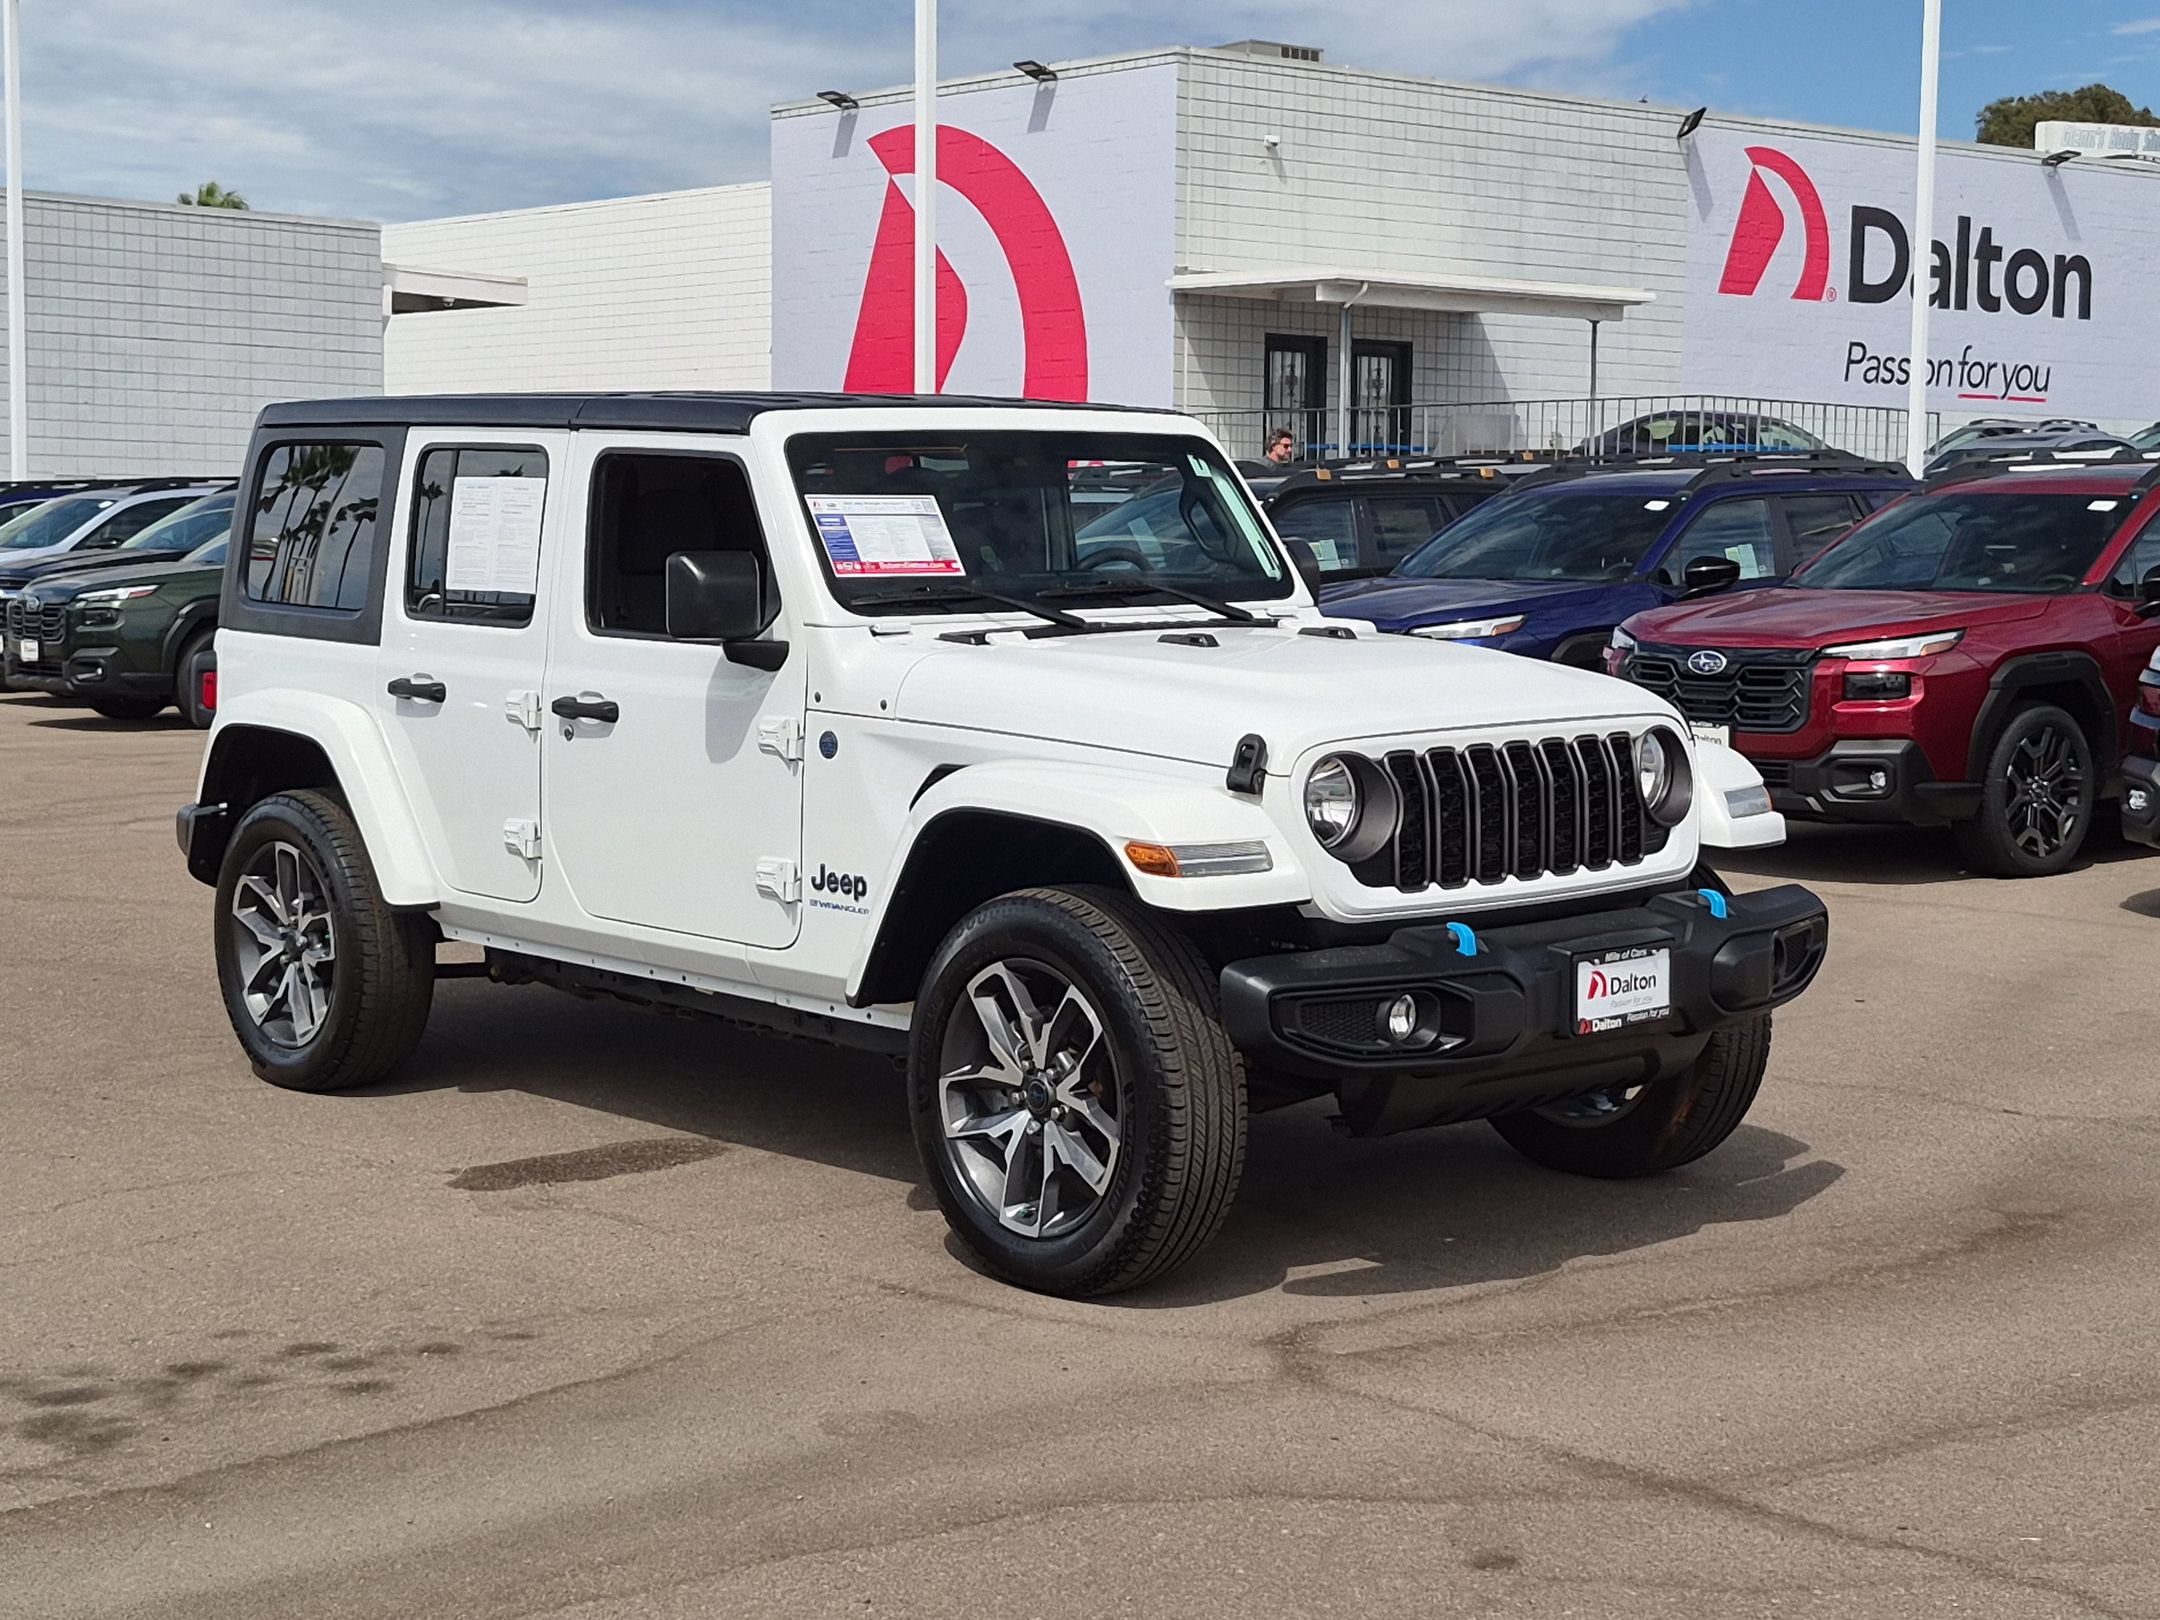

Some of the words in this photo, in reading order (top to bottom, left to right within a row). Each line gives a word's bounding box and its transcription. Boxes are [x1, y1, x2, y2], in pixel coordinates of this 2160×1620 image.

[1848, 205, 2092, 320] Dalton
[1844, 341, 1953, 387] Passon
[1957, 345, 1998, 388] for
[2000, 363, 2051, 400] you
[811, 863, 867, 902] Jeep
[1630, 948, 1647, 958] Cars
[1610, 973, 1656, 995] Dalton
[1592, 1018, 1622, 1032] Dalton
